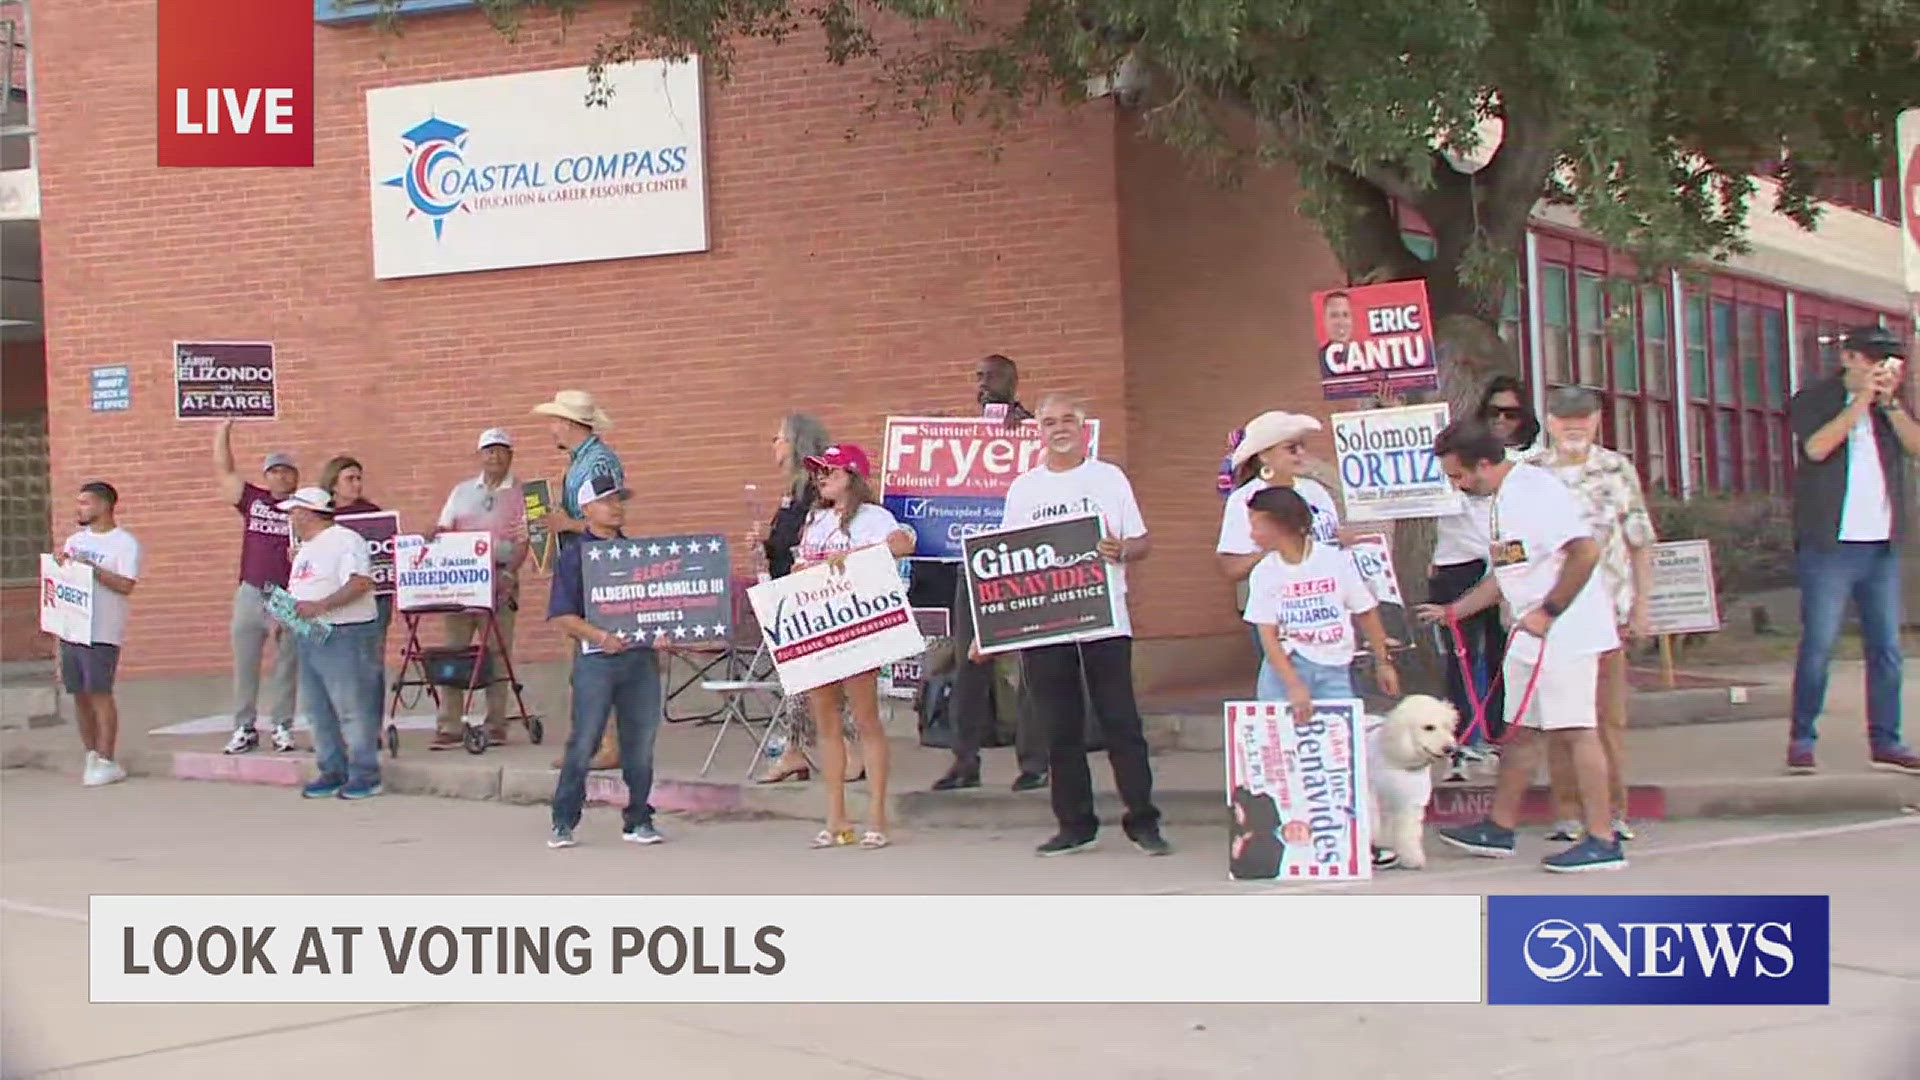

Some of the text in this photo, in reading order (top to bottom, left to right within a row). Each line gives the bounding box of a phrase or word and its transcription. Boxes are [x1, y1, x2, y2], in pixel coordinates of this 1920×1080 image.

[554, 146, 688, 184] COMPASS
[474, 178, 688, 210] EDUCATION & CAREER RESOURCE CENTER
[1368, 304, 1421, 333] ERIC
[1325, 336, 1426, 374] CANTU
[178, 366, 272, 381] ELIZONDO
[182, 392, 272, 410] AT-LARGE
[919, 424, 979, 438] Samuel
[1336, 420, 1433, 453] Solomon
[885, 473, 940, 488] Colonel
[1342, 448, 1441, 488] ORTIZ
[973, 542, 1056, 580] Gina
[399, 568, 490, 586] ARREDONDO
[591, 578, 724, 602] ALBERTO CARRILLO III
[795, 579, 852, 606] Denise
[978, 562, 1106, 604] BENAVIDES
[44, 578, 89, 609] ROBERT
[981, 585, 1105, 615] FOR CHIEF JUSTICE
[637, 611, 675, 624] DISTRICT
[795, 641, 824, 657] State
[824, 612, 906, 646] Representative
[1294, 719, 1343, 864] Benavides
[1325, 768, 1348, 799] Joe
